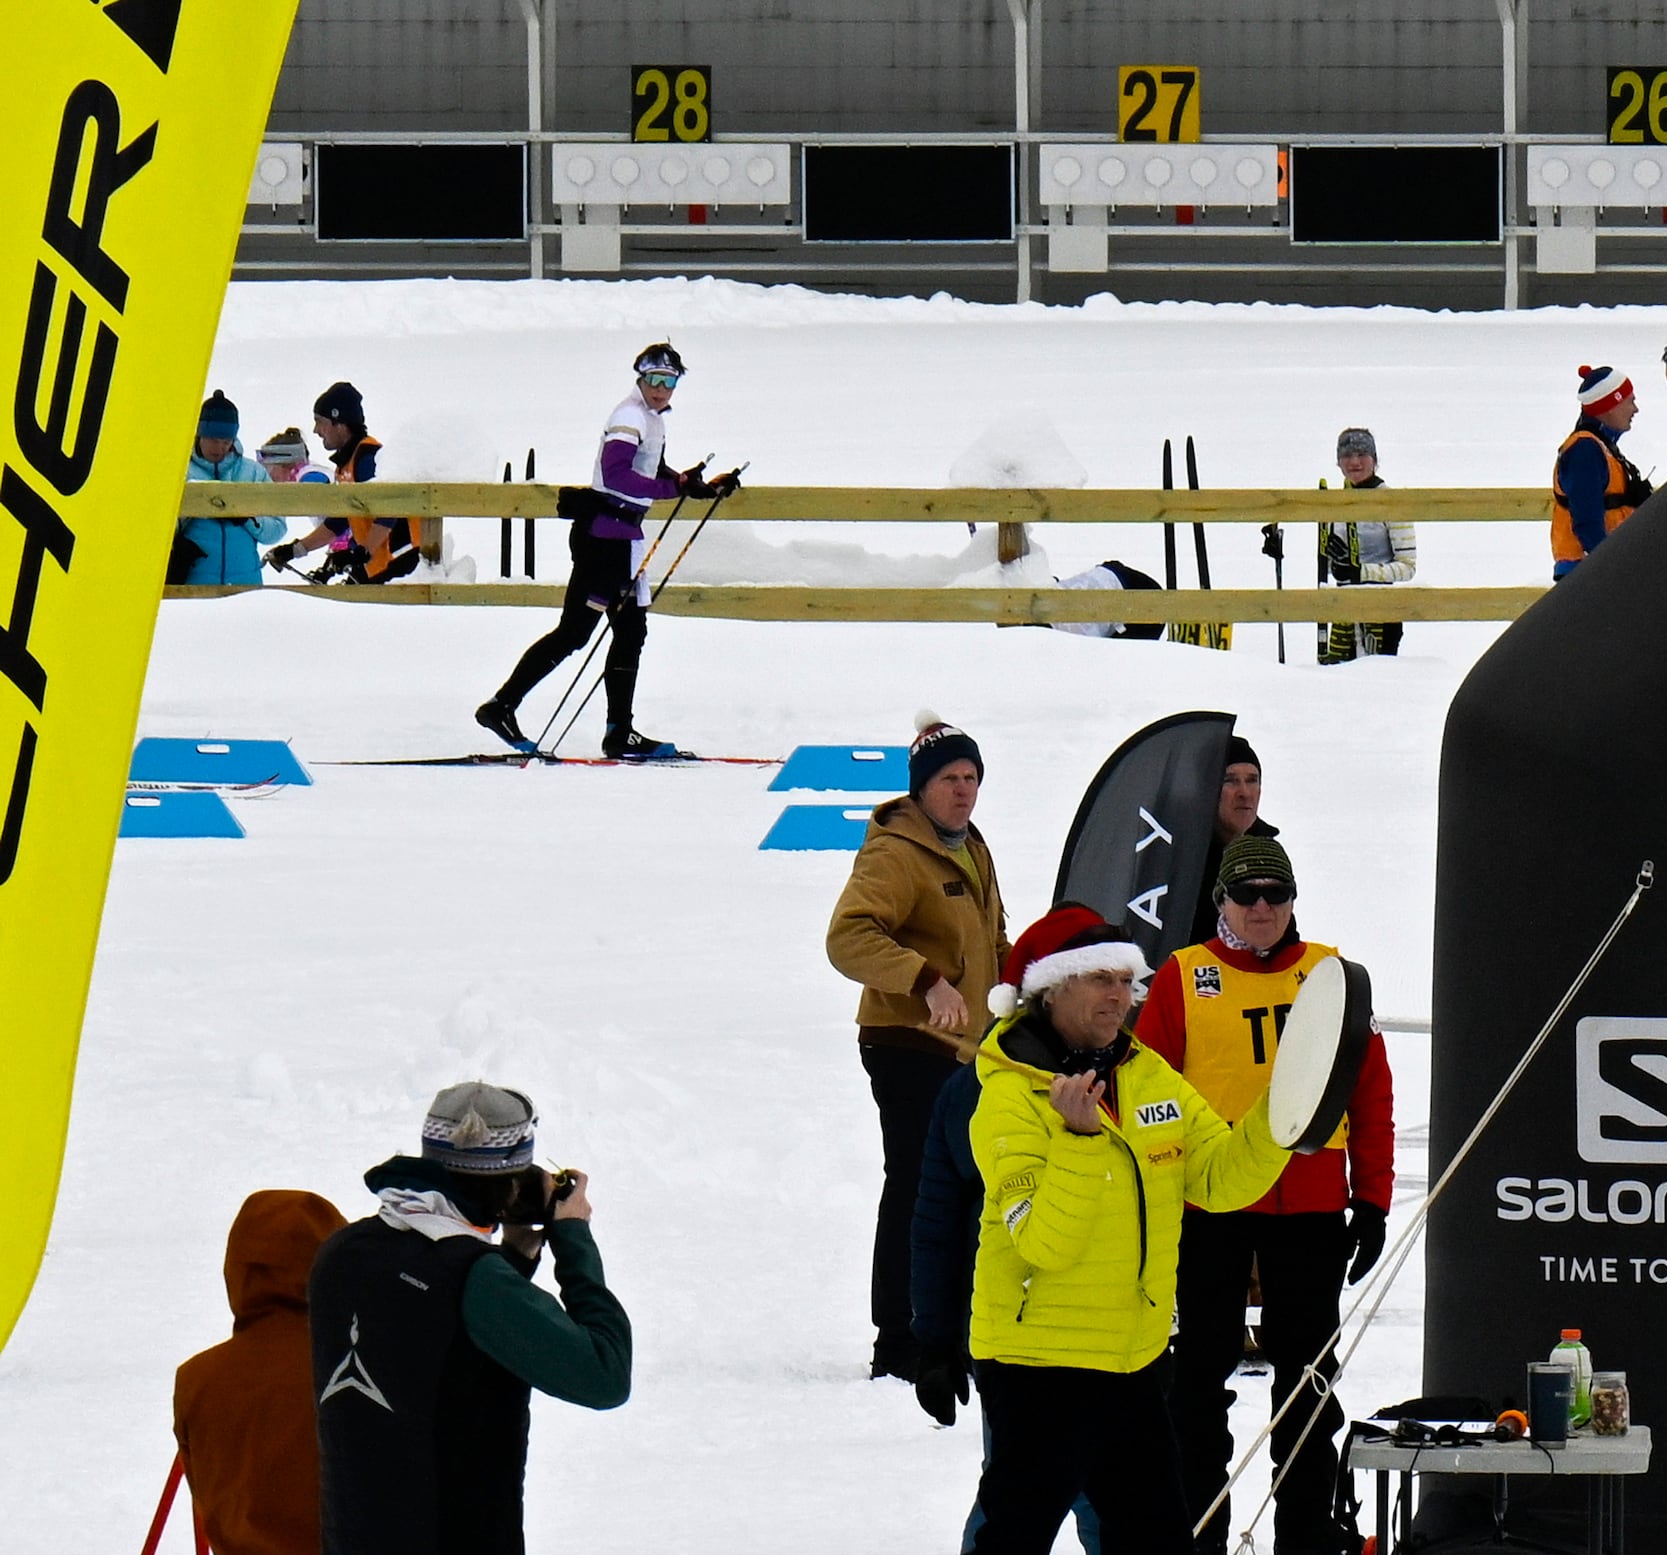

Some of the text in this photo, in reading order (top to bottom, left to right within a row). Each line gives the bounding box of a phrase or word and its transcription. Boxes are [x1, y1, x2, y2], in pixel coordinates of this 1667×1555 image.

[636, 69, 708, 142] 28
[1123, 70, 1196, 142] 27
[1194, 966, 1220, 978] US
[1137, 1102, 1180, 1125] VISA
[1148, 1150, 1172, 1165] Sprint
[1540, 1256, 1618, 1283] TIME
